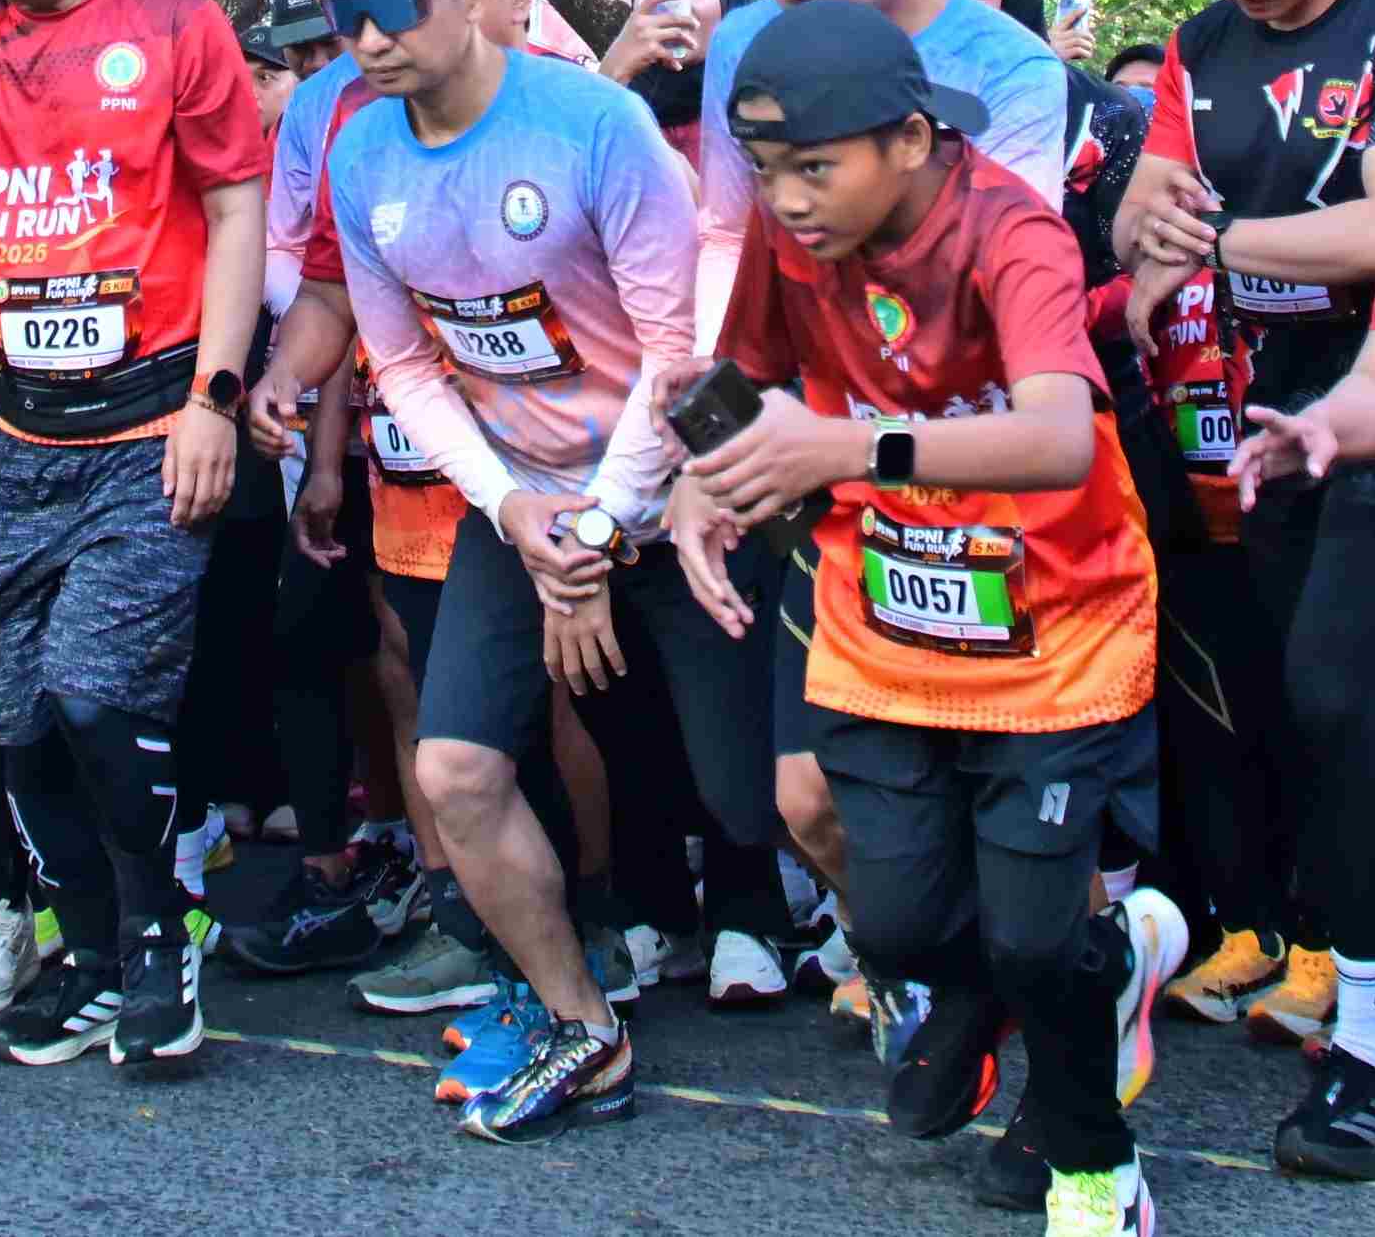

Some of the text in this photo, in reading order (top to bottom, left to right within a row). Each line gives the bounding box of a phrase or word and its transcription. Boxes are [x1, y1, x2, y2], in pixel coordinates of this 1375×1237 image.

[100, 98, 137, 111] PPNI
[15, 206, 82, 237] RUN
[47, 276, 81, 289] PPNI
[24, 316, 100, 350] 0226
[454, 329, 526, 358] 0288
[1201, 345, 1222, 362] 20
[1201, 416, 1232, 443] 00
[904, 527, 944, 543] PPNI
[904, 541, 925, 555] FUN
[888, 568, 967, 615] 0057
